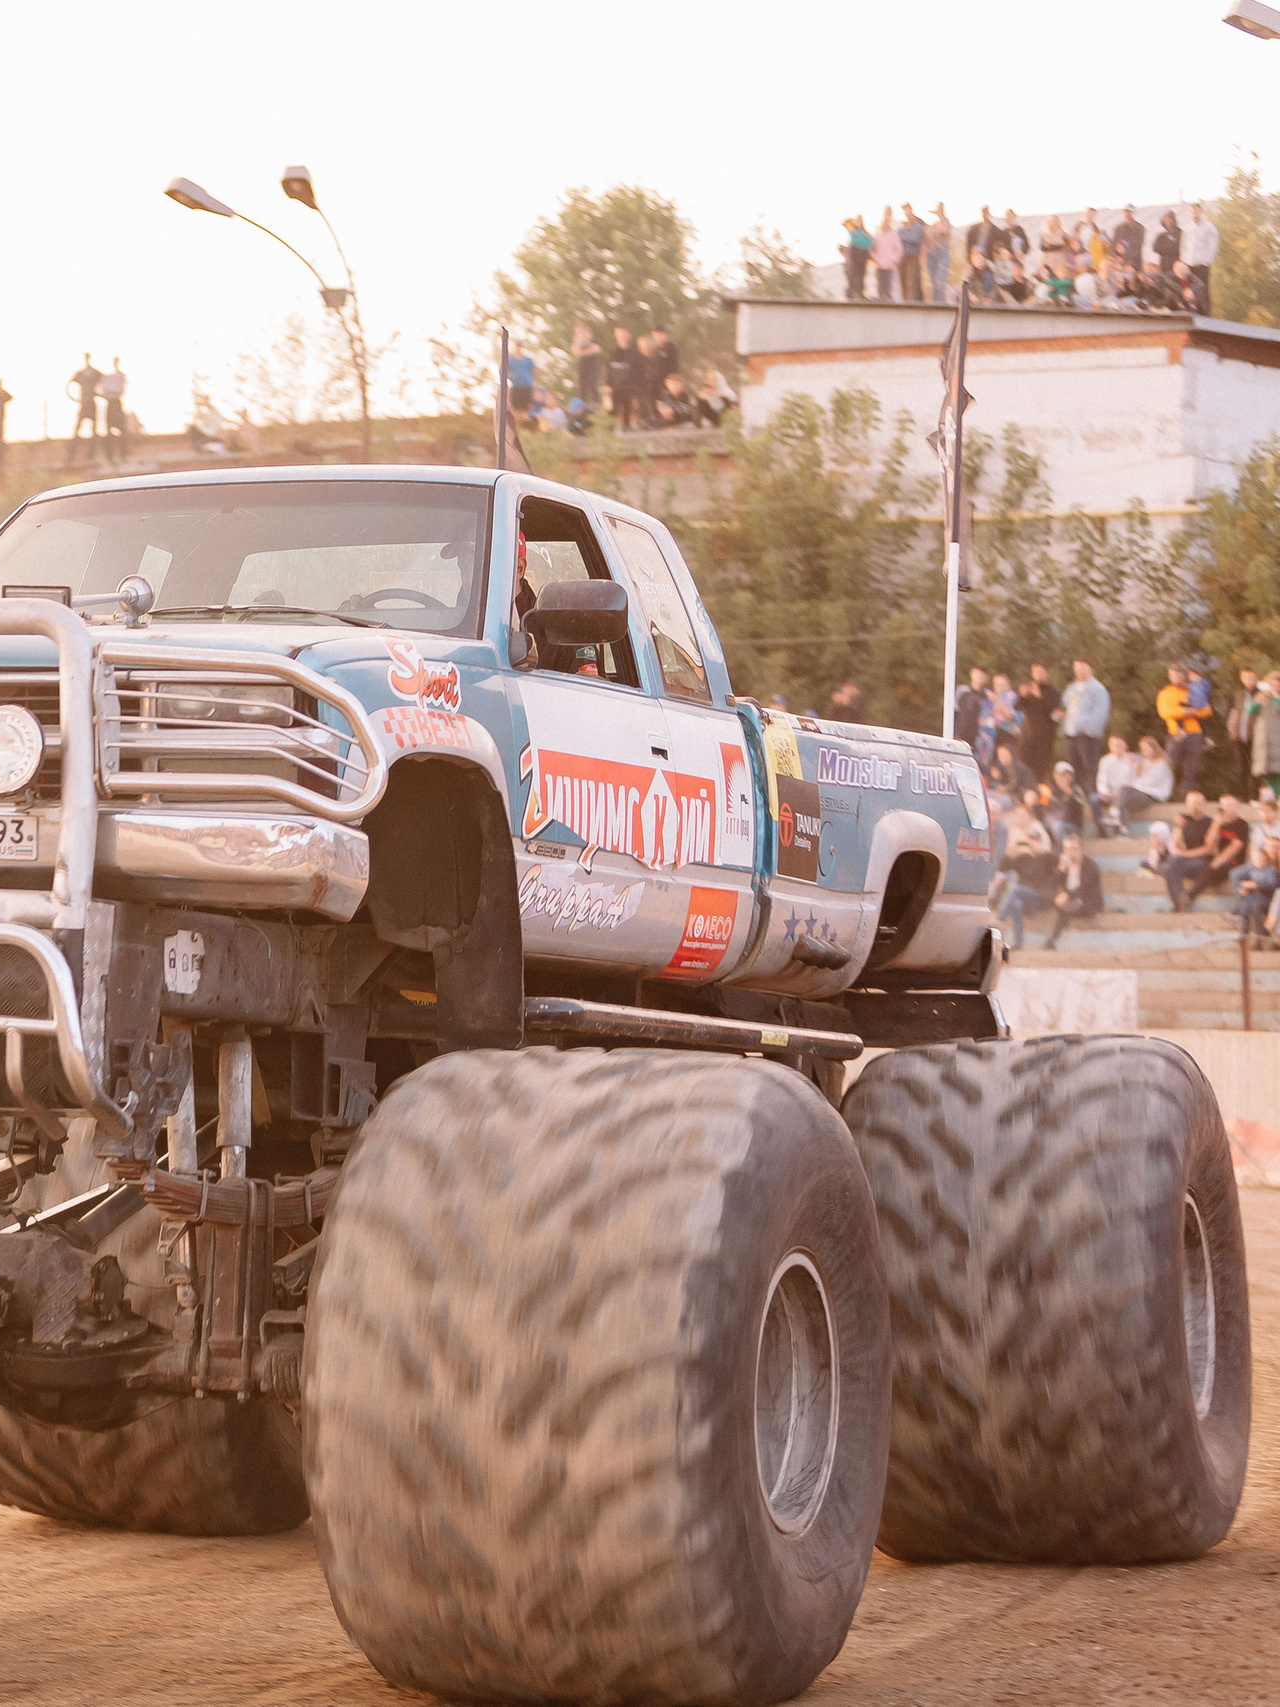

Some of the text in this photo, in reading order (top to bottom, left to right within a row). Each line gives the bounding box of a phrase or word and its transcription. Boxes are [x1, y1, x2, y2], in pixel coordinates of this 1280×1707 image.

[638, 581, 672, 596] RECORD
[382, 635, 460, 710] Sport
[817, 746, 902, 791] Monster
[908, 758, 957, 795] truck
[685, 913, 732, 941] КОЛЕСО
